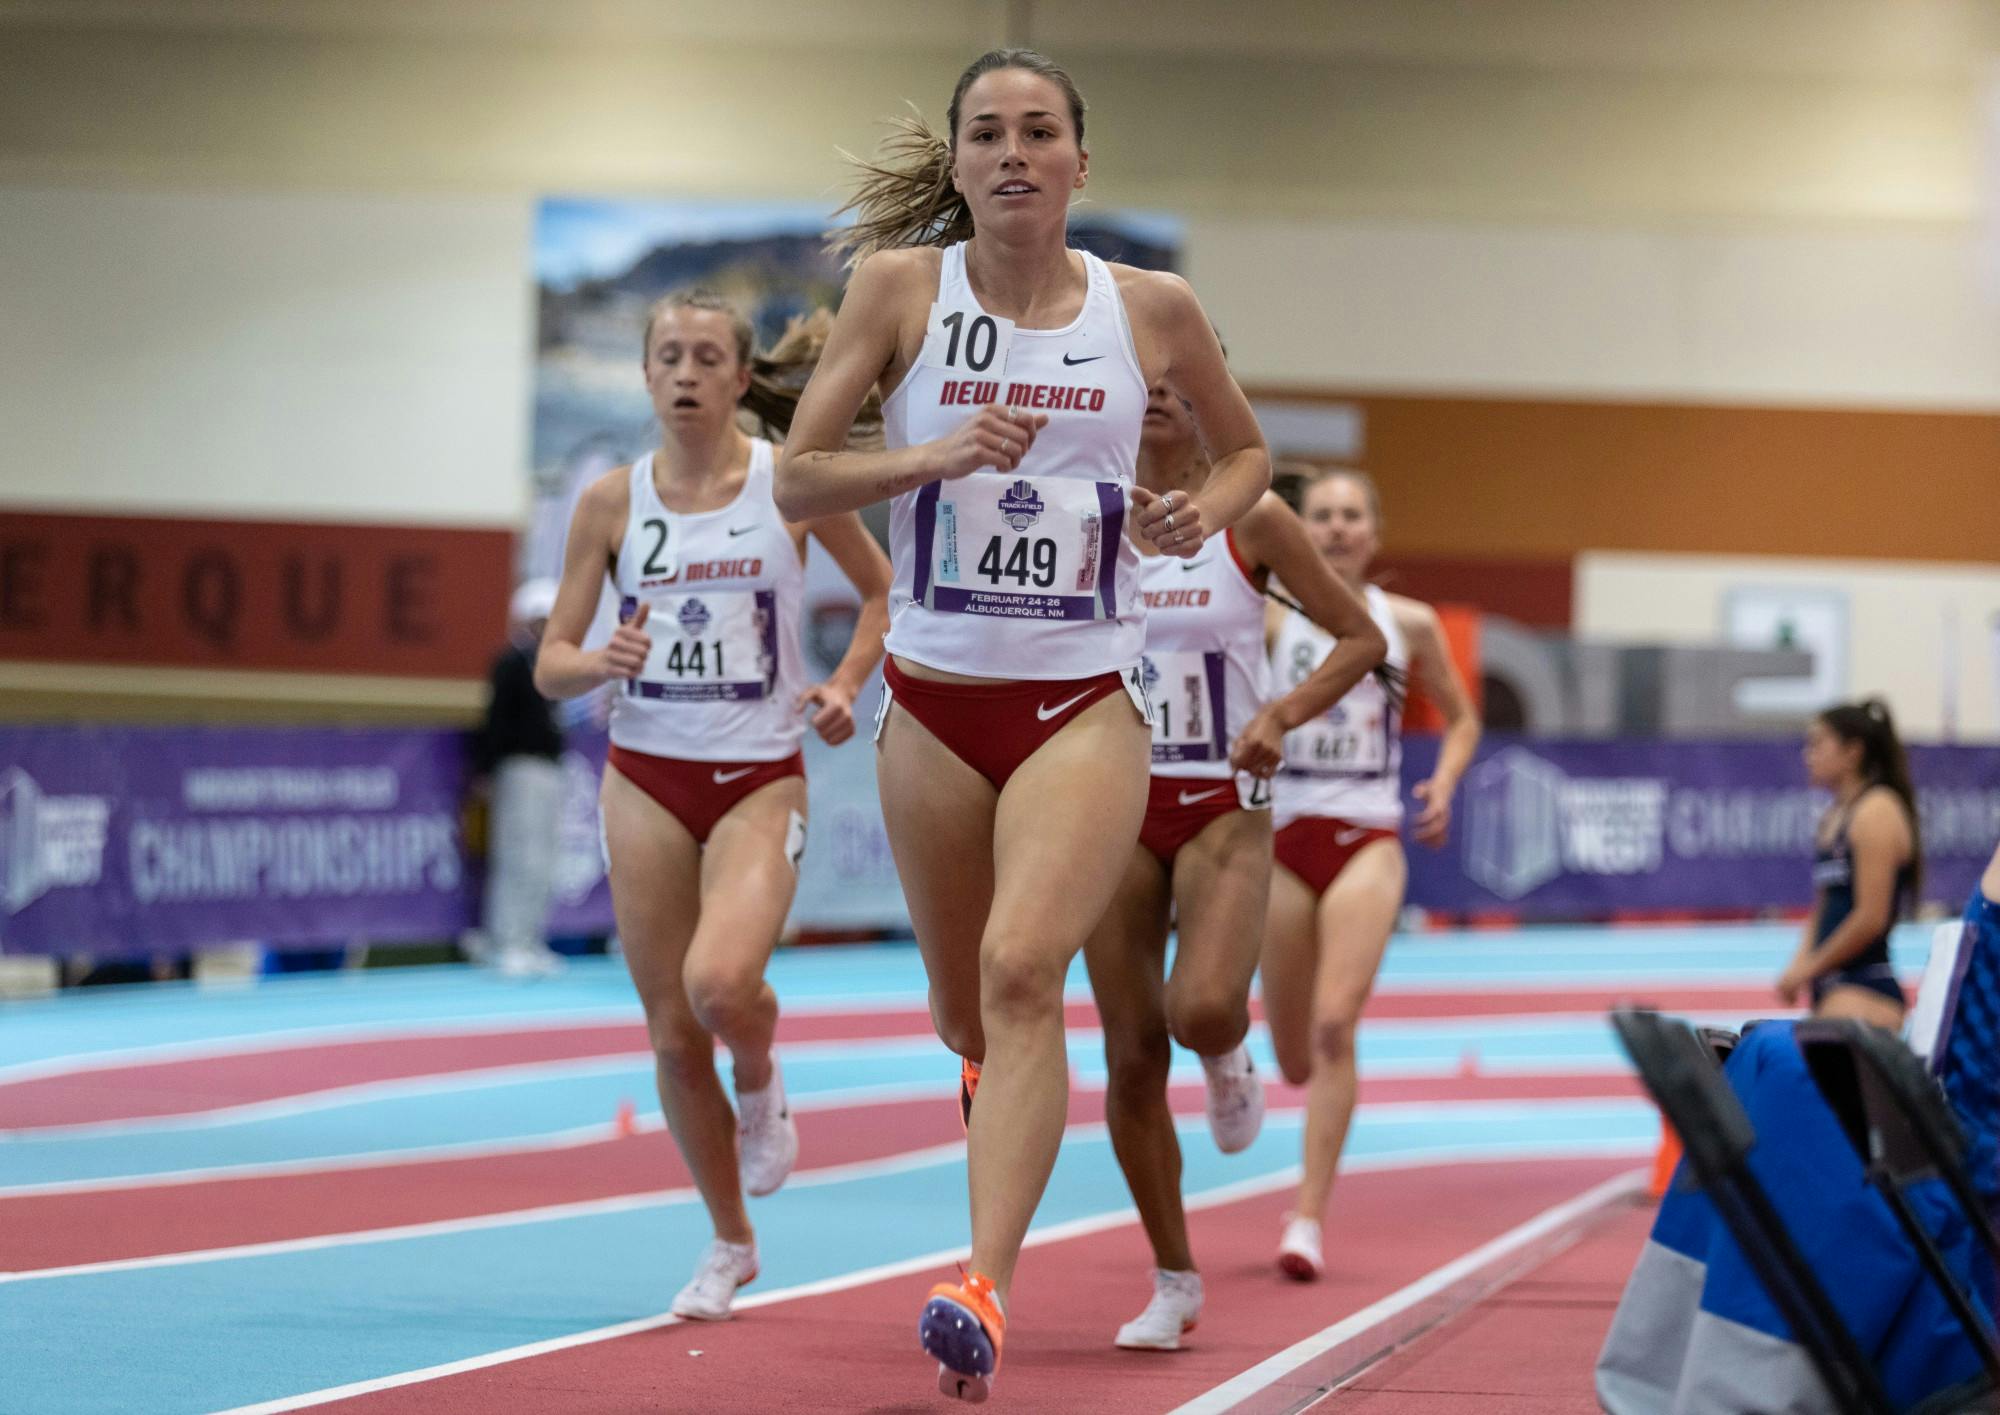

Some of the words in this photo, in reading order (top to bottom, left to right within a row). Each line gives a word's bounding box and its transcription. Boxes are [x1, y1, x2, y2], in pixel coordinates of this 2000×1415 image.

[942, 311, 998, 372] 10
[939, 381, 1000, 406] NEW
[1005, 383, 1106, 412] MEXICO
[643, 519, 668, 576] 2
[977, 535, 1057, 588] 449
[686, 558, 762, 581] MEXICO
[971, 593, 1026, 604] FEBRUARY
[1048, 609, 1065, 618] NM
[667, 640, 724, 677] 441
